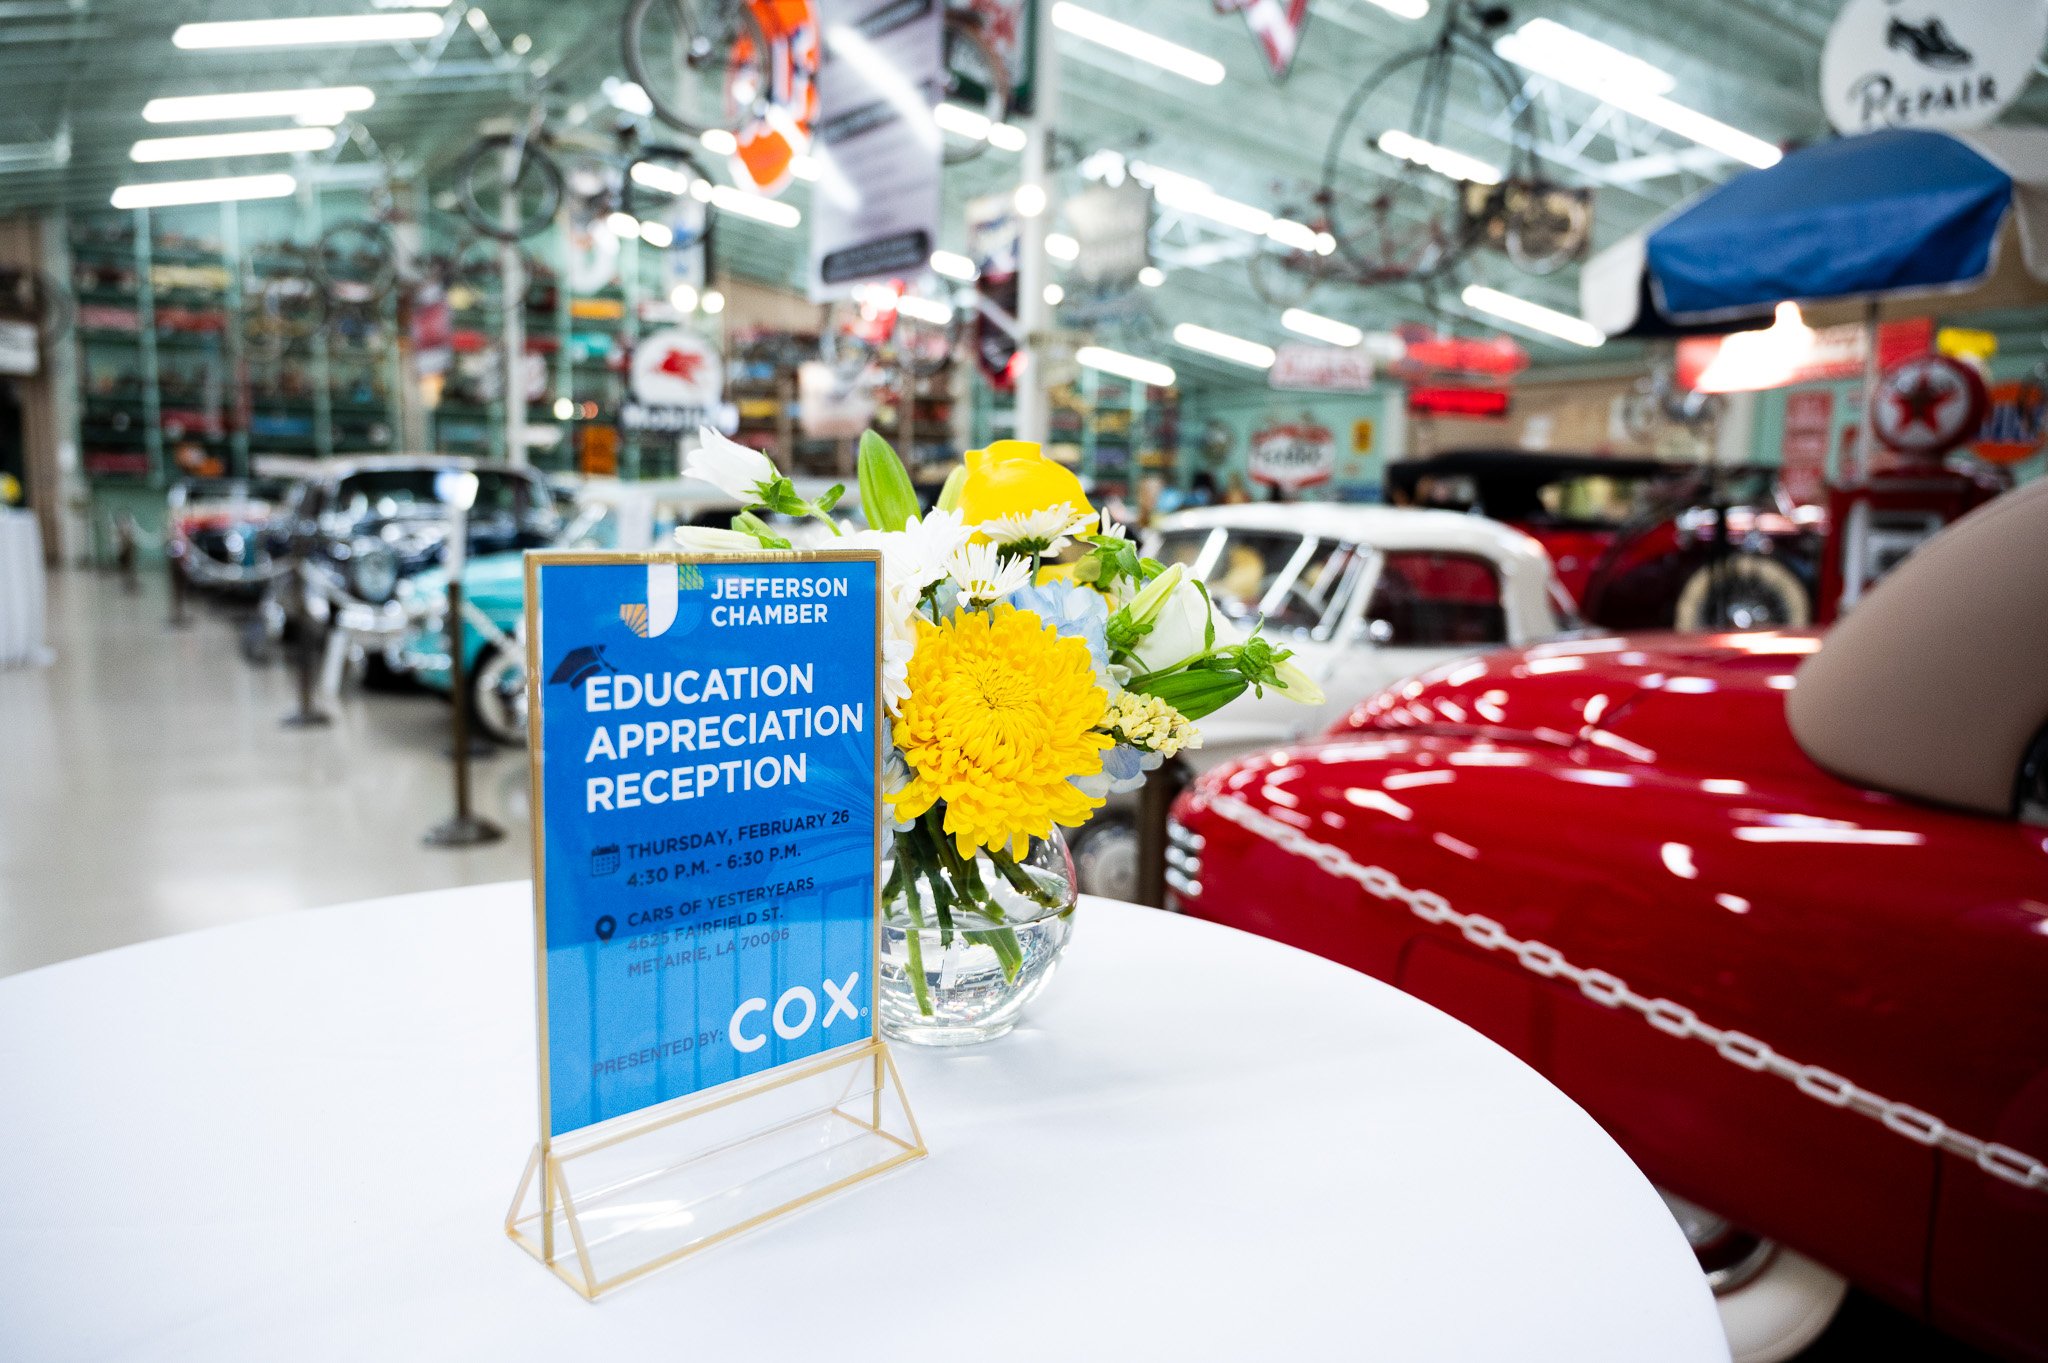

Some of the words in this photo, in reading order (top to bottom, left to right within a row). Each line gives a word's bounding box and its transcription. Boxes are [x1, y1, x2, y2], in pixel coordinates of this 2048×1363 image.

[711, 578, 848, 600] JEFFERSON
[711, 604, 828, 627] CHAMBER
[585, 662, 813, 713] EDUCATION
[584, 703, 863, 763] APPRECIATION
[586, 752, 807, 813] RECEPTION
[627, 829, 733, 860] THURSDAY,
[738, 814, 827, 842] FEBRUARY
[832, 809, 850, 825] 26
[627, 867, 669, 887] 4:30
[675, 860, 710, 880] P.M.
[727, 851, 764, 870] 6:30
[769, 844, 801, 861] P.M.
[628, 905, 674, 928] CARS
[679, 899, 703, 917] OF
[707, 877, 815, 911] YESTERYEARS
[627, 930, 670, 952] 4625
[675, 912, 757, 942] FAIRFIELD
[762, 906, 784, 923] ST.
[628, 947, 712, 977] METAIRIE,
[716, 939, 738, 957] LA
[741, 928, 790, 950] 70006
[592, 1037, 694, 1080] PRESENTED
[700, 1028, 724, 1049] BY:
[729, 971, 860, 1053] COX
